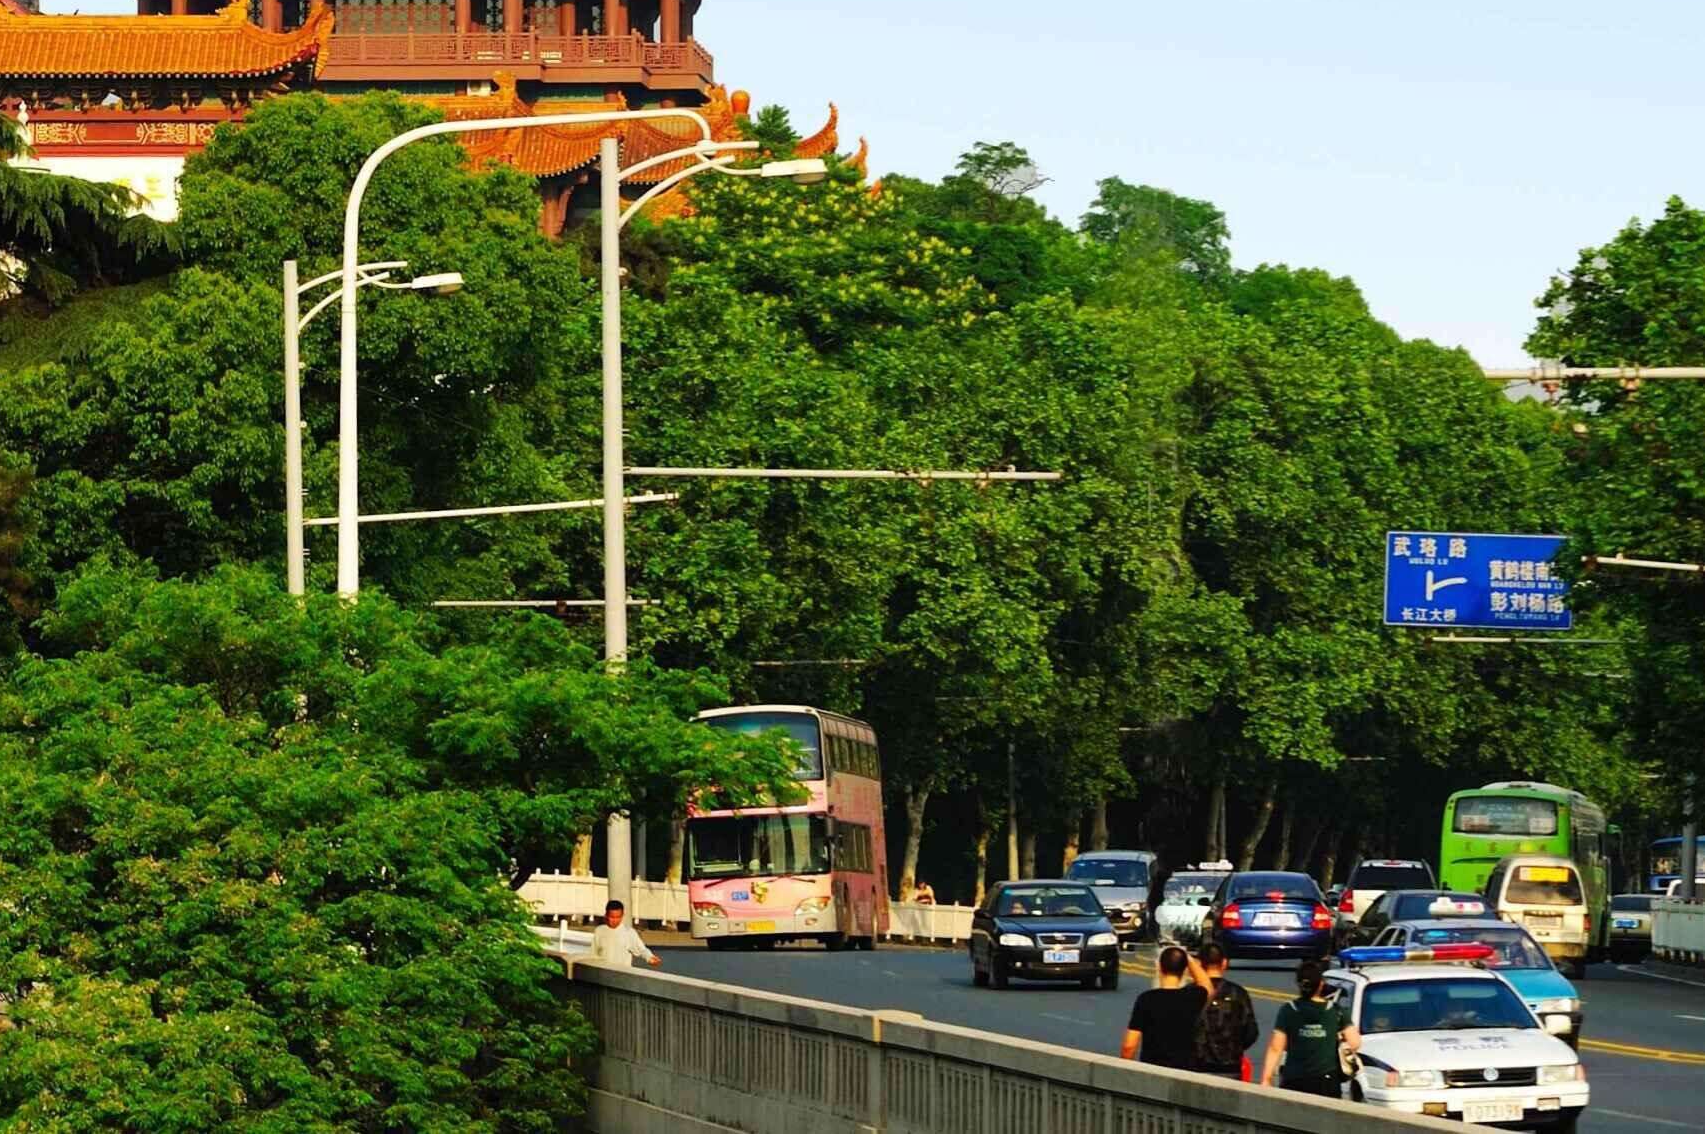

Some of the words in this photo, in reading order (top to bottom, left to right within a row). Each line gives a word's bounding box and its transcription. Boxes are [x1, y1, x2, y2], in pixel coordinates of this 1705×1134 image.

[1393, 536, 1467, 558] 武珞路
[1489, 560, 1563, 581] 黄鹤楼南
[1490, 591, 1564, 614] 彭刘杨路
[1401, 607, 1457, 622] 长江大桥
